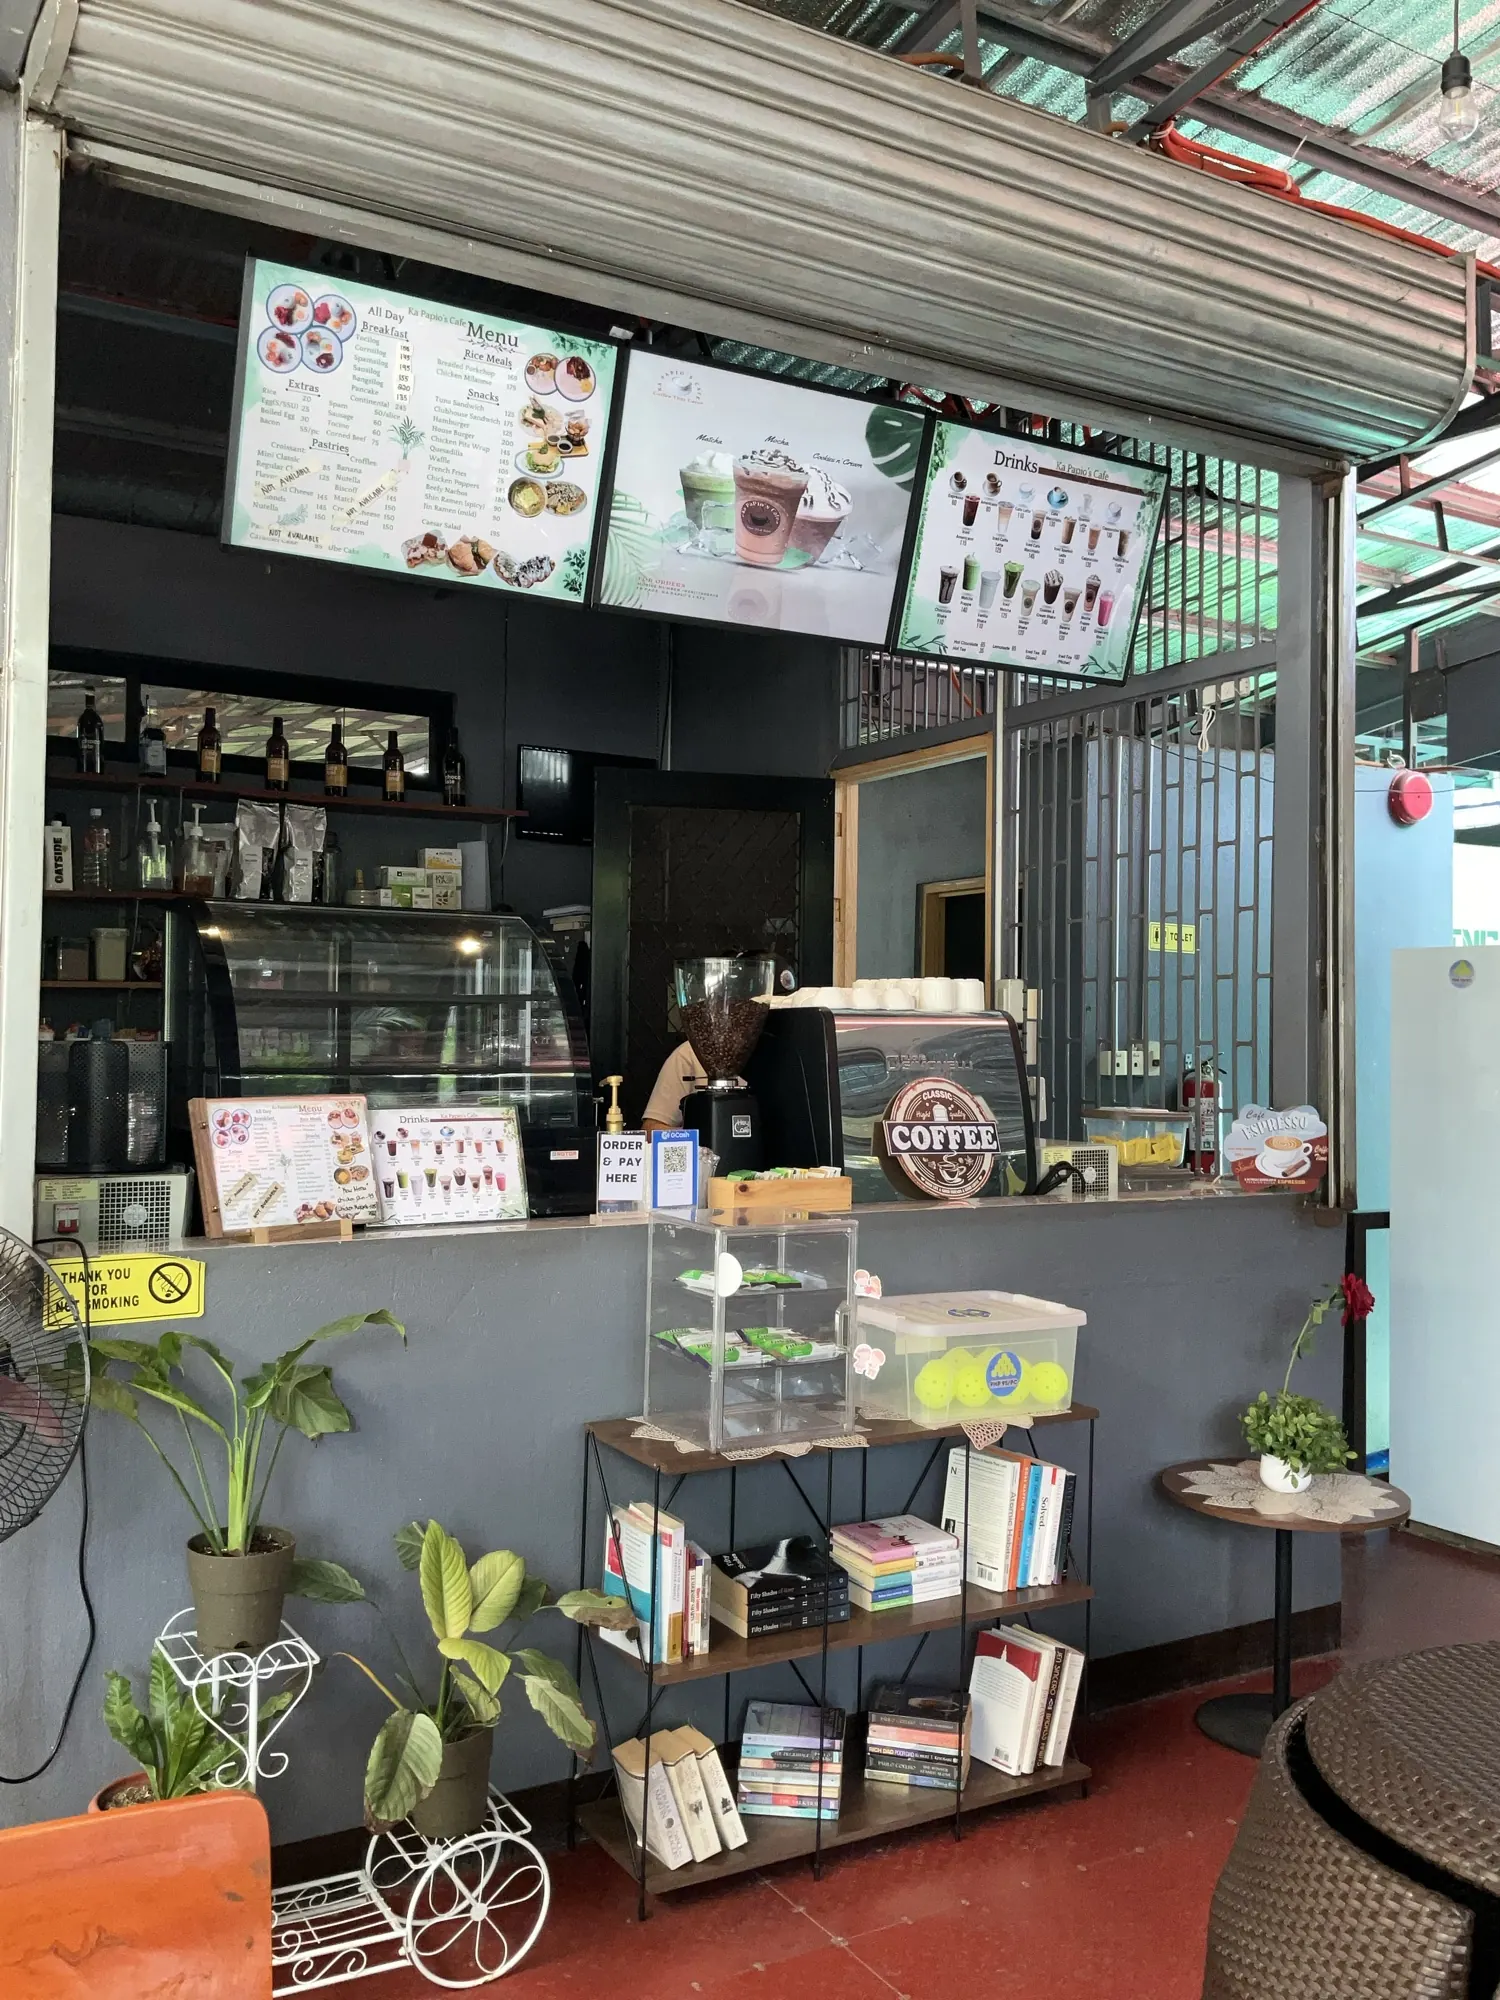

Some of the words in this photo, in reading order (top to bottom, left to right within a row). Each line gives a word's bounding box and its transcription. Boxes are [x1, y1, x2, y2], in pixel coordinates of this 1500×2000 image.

[368, 306, 382, 317] All
[384, 310, 405, 324] Day
[408, 307, 419, 316] Ka
[421, 310, 449, 323] Papio's
[449, 317, 467, 327] Cafe
[362, 321, 408, 339] Breakfast
[466, 321, 519, 348] Menu
[465, 349, 484, 361] Rice
[486, 353, 513, 368] Meals
[436, 369, 462, 380] Chicken
[262, 387, 277, 395] Rice
[288, 379, 320, 393] Extras
[351, 385, 379, 396] Pancake
[350, 395, 390, 408] Continental
[468, 389, 500, 403] Snacks
[329, 401, 348, 409] Spam
[435, 396, 452, 406] Tuna
[453, 400, 485, 412] Sandwich
[260, 407, 282, 417] Boiled
[283, 411, 296, 421] Egg
[328, 410, 354, 421] Sausage
[434, 405, 467, 420] Clubhouse
[468, 413, 501, 426] Sandwich
[260, 417, 281, 426] Bacon
[433, 415, 470, 429] Hamburger
[326, 430, 350, 440] Corned
[352, 433, 366, 442] Beef
[432, 425, 451, 436] House
[453, 429, 475, 440] Burger
[312, 438, 350, 453] Pastries
[431, 435, 457, 447] Chicken
[458, 440, 471, 450] Pita
[472, 443, 491, 454] Wrap
[696, 434, 724, 445] Matcha
[764, 435, 789, 446] Mocha
[257, 450, 274, 459] Mini
[276, 452, 300, 463] Classic
[429, 455, 451, 465] Waffle
[993, 450, 1038, 474] Drinks
[256, 460, 283, 471] Regular
[336, 464, 363, 474] Banana
[428, 464, 450, 475] French
[451, 468, 467, 477] Fries
[842, 459, 864, 469] Cream
[1056, 461, 1067, 472] Ka
[1068, 463, 1092, 478] Papio's
[1093, 469, 1109, 481] Cafe
[261, 483, 276, 495] NOT
[279, 466, 311, 488] AVAILABLE
[336, 474, 361, 484] Nutella
[426, 474, 452, 486] Chicken
[334, 484, 358, 493] Biscoff
[426, 484, 447, 495] Beefy
[449, 488, 468, 497] Nachos
[359, 484, 386, 508] AVAILABLE
[425, 493, 440, 503] Shin
[441, 497, 463, 507] Ramen
[253, 501, 279, 512] Nutella
[434, 505, 456, 515] Ramen
[330, 525, 341, 533] Ice
[342, 526, 365, 536] Cream
[421, 519, 442, 529] Caesar
[444, 522, 462, 531] Salad
[269, 529, 281, 538] NOT
[288, 531, 319, 543] AVAILABLE
[54, 837, 63, 884] OATSIDE
[1170, 933, 1192, 942] TOET
[922, 1089, 953, 1101] CLASSIC
[400, 1115, 430, 1124] Drinks
[1241, 1116, 1308, 1140] ESPRESSO
[891, 1125, 997, 1151] COFFEE
[603, 1141, 643, 1150] ORDER
[602, 1157, 612, 1166] &
[619, 1157, 642, 1167] PAY
[606, 1174, 637, 1183] HERE
[224, 1198, 233, 1207] NOT
[253, 1209, 261, 1219] NOT
[261, 1186, 279, 1208] AVAILABLE
[61, 1270, 102, 1284] THANK
[107, 1268, 130, 1280] YOU
[1008, 1492, 1016, 1527] Atomic
[1038, 1497, 1048, 1530] Solved.
[1005, 1528, 1013, 1560] Habits
[763, 1606, 779, 1614] Shades
[751, 1626, 762, 1634] Fifty
[763, 1623, 779, 1631] Shades
[878, 1760, 894, 1768] PAULO
